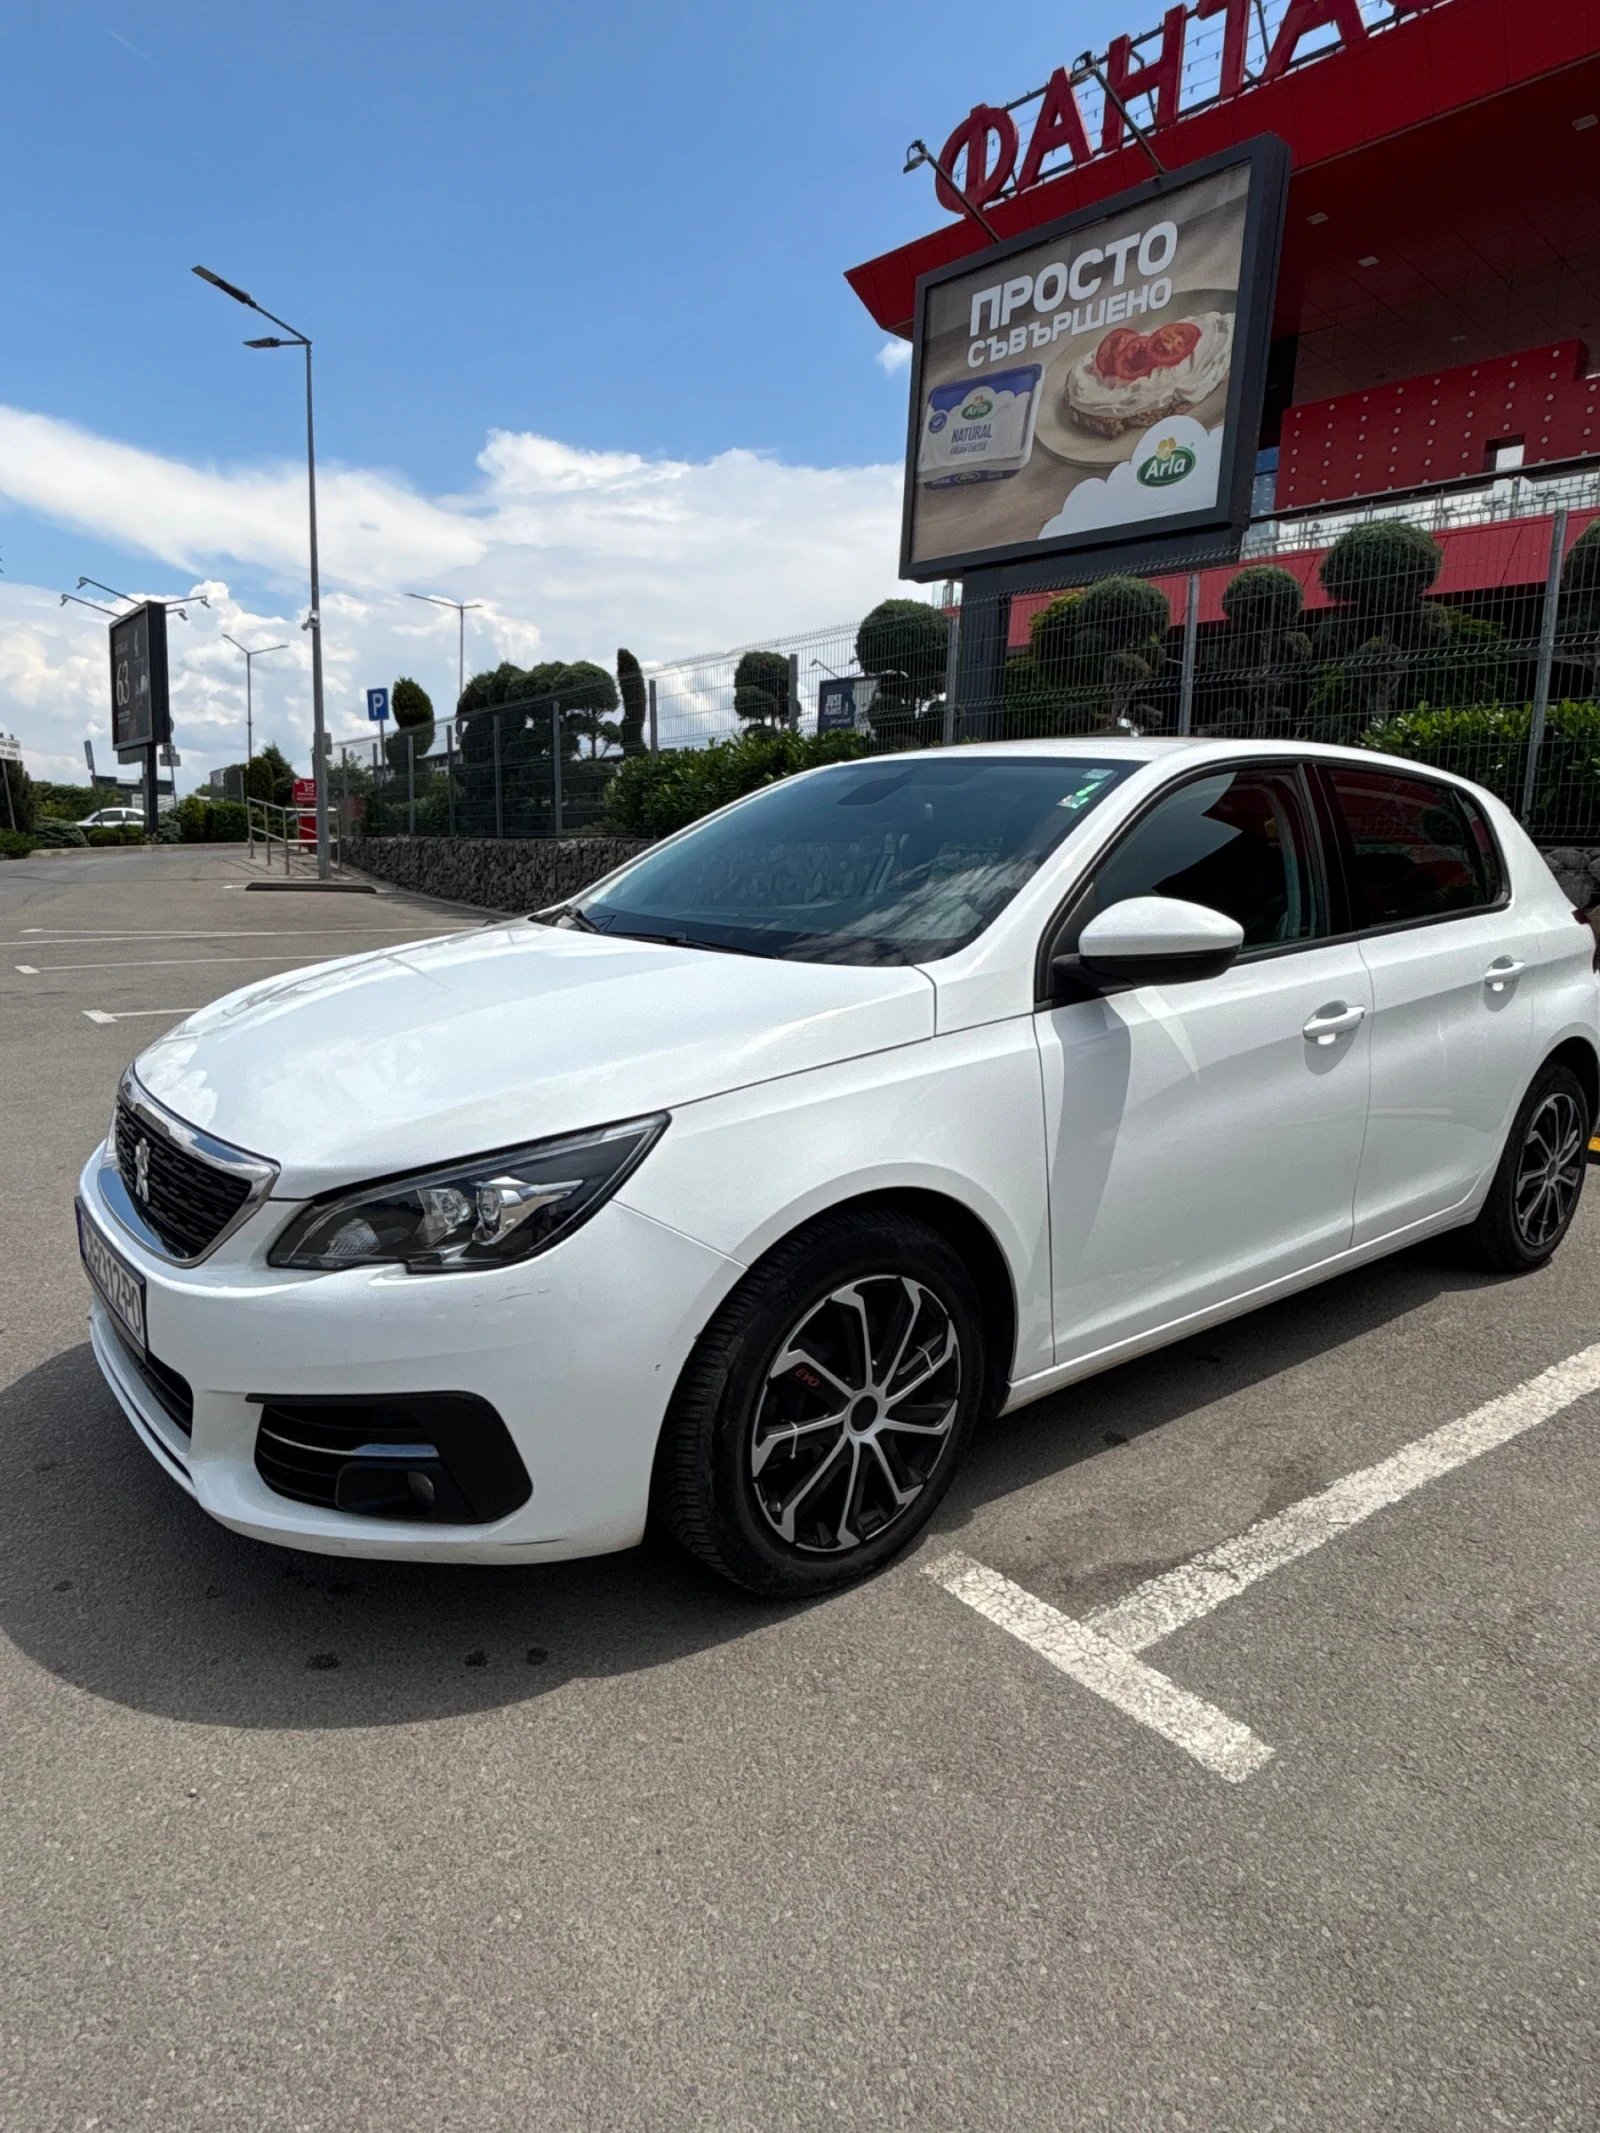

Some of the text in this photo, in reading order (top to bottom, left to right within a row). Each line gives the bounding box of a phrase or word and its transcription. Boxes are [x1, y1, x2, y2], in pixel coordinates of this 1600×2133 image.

[935, 0, 1430, 217] ФАНТА
[969, 221, 1178, 337] ПРОСТО
[967, 277, 1173, 368] СЪВЪРШЕНО
[964, 401, 989, 418] Arla
[951, 423, 992, 443] NATURAL
[1144, 454, 1186, 480] Arla
[116, 659, 130, 706] 63
[372, 693, 384, 717] P
[795, 1368, 820, 1386] EVO
